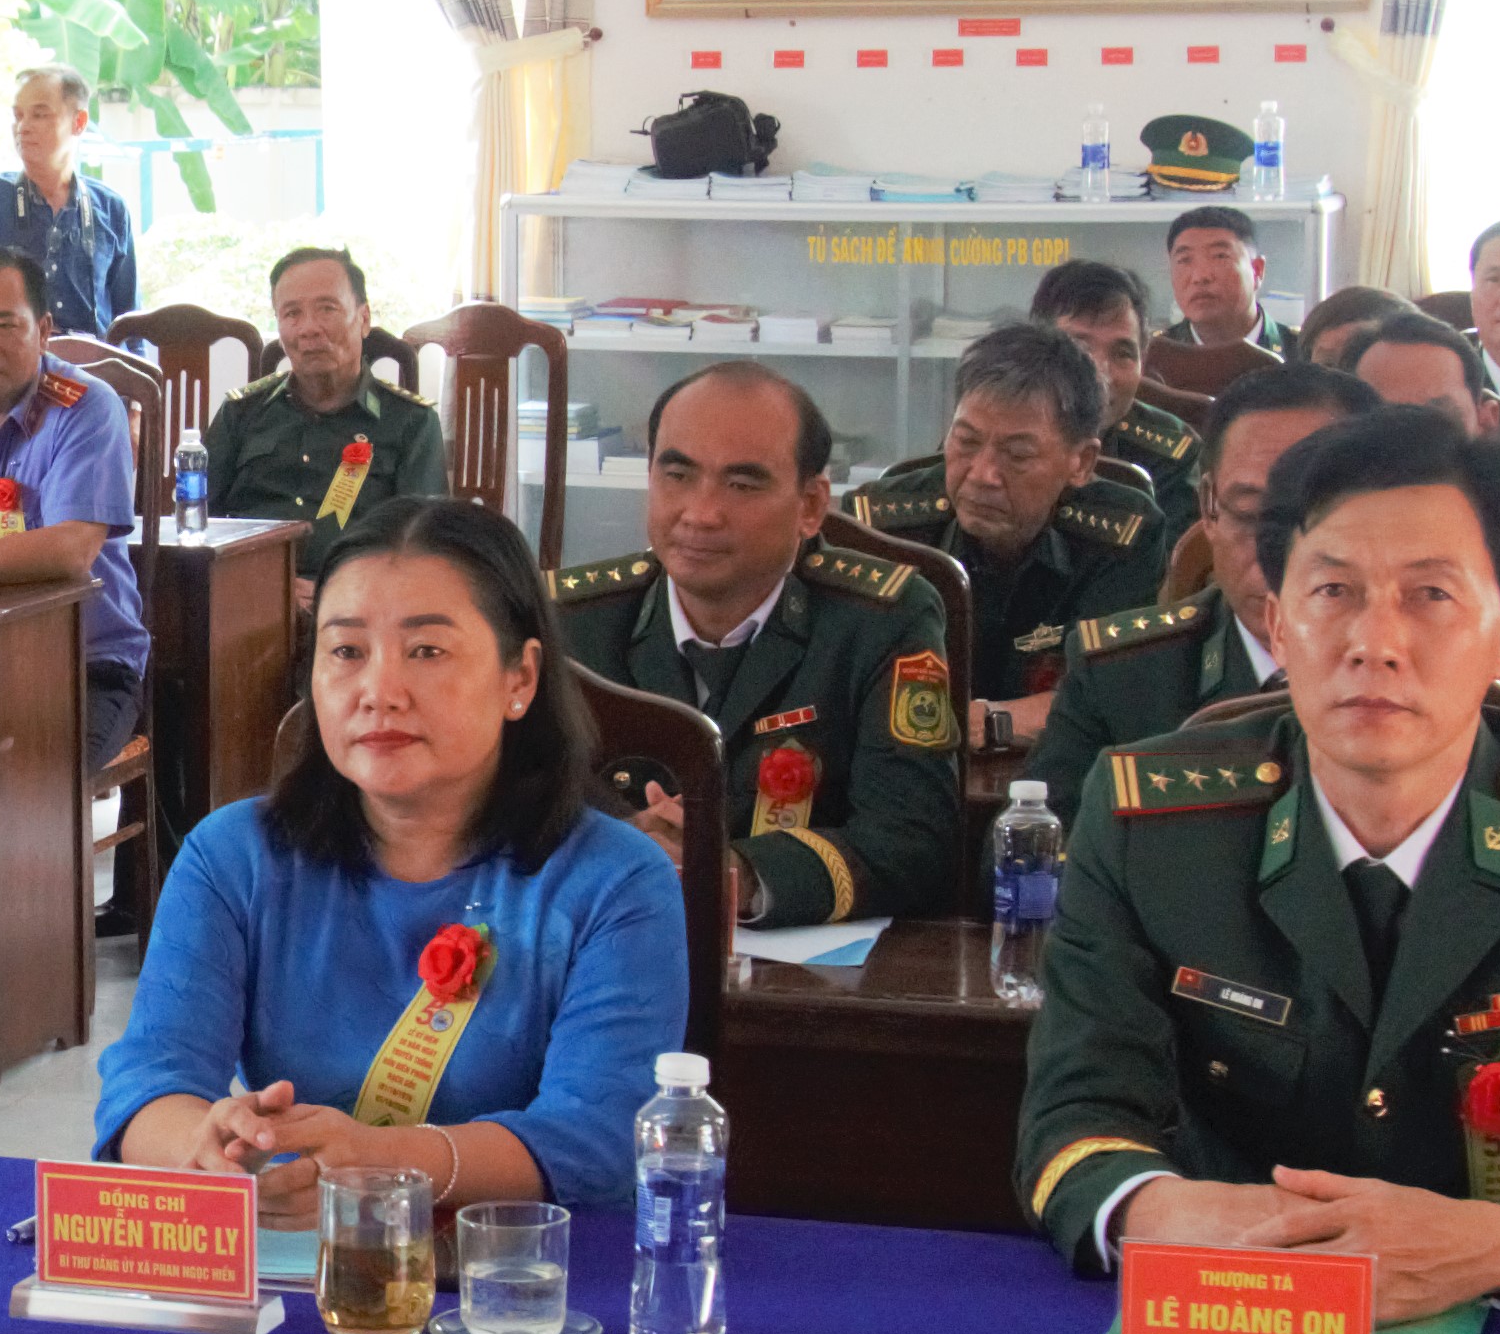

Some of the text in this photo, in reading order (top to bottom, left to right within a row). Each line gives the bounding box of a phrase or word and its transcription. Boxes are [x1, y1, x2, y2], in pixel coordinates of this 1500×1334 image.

[807, 224, 827, 263] TỦ
[831, 228, 874, 264] SÁCH
[950, 227, 1002, 266] CƯỜNG
[1007, 238, 1028, 265] PB
[99, 1187, 185, 1213] ĐỒNG CHÍ
[53, 1208, 238, 1256] NGUYỄN TRÚC LY
[152, 1262, 180, 1277] PHAN
[182, 1264, 210, 1281] NGỌC
[1199, 1270, 1294, 1291] THƯỢNG TÁ
[1146, 1296, 1180, 1328] LÊ
